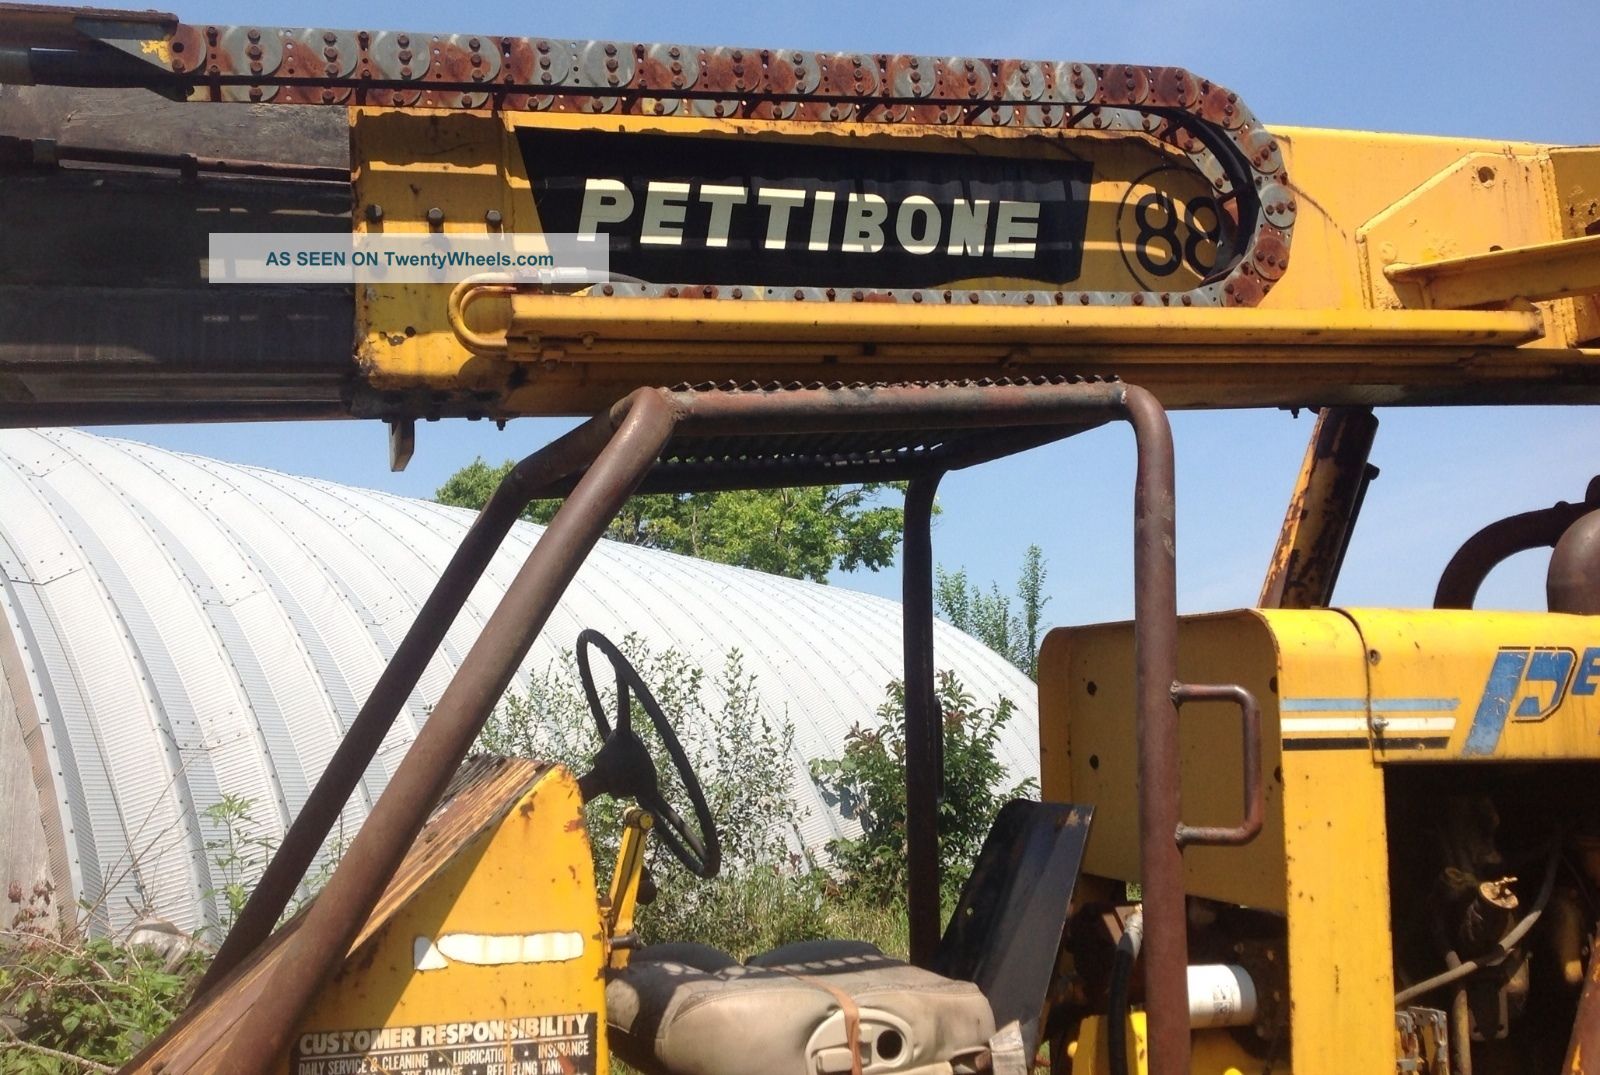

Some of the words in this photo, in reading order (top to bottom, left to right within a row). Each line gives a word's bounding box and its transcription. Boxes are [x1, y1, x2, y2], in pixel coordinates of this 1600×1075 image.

[577, 178, 1041, 259] PETTIBONE
[1135, 193, 1222, 277] 88
[299, 1060, 326, 1075] DAILY
[328, 1057, 367, 1075] SERVICE
[370, 1056, 379, 1073] &
[382, 1053, 429, 1071] CLEANING
[452, 1047, 514, 1066] LUBRICATION
[538, 1041, 589, 1059] INSURANCE
[300, 1027, 416, 1055] CUSTOMER
[420, 1013, 589, 1047] RESPONSIBILITY
